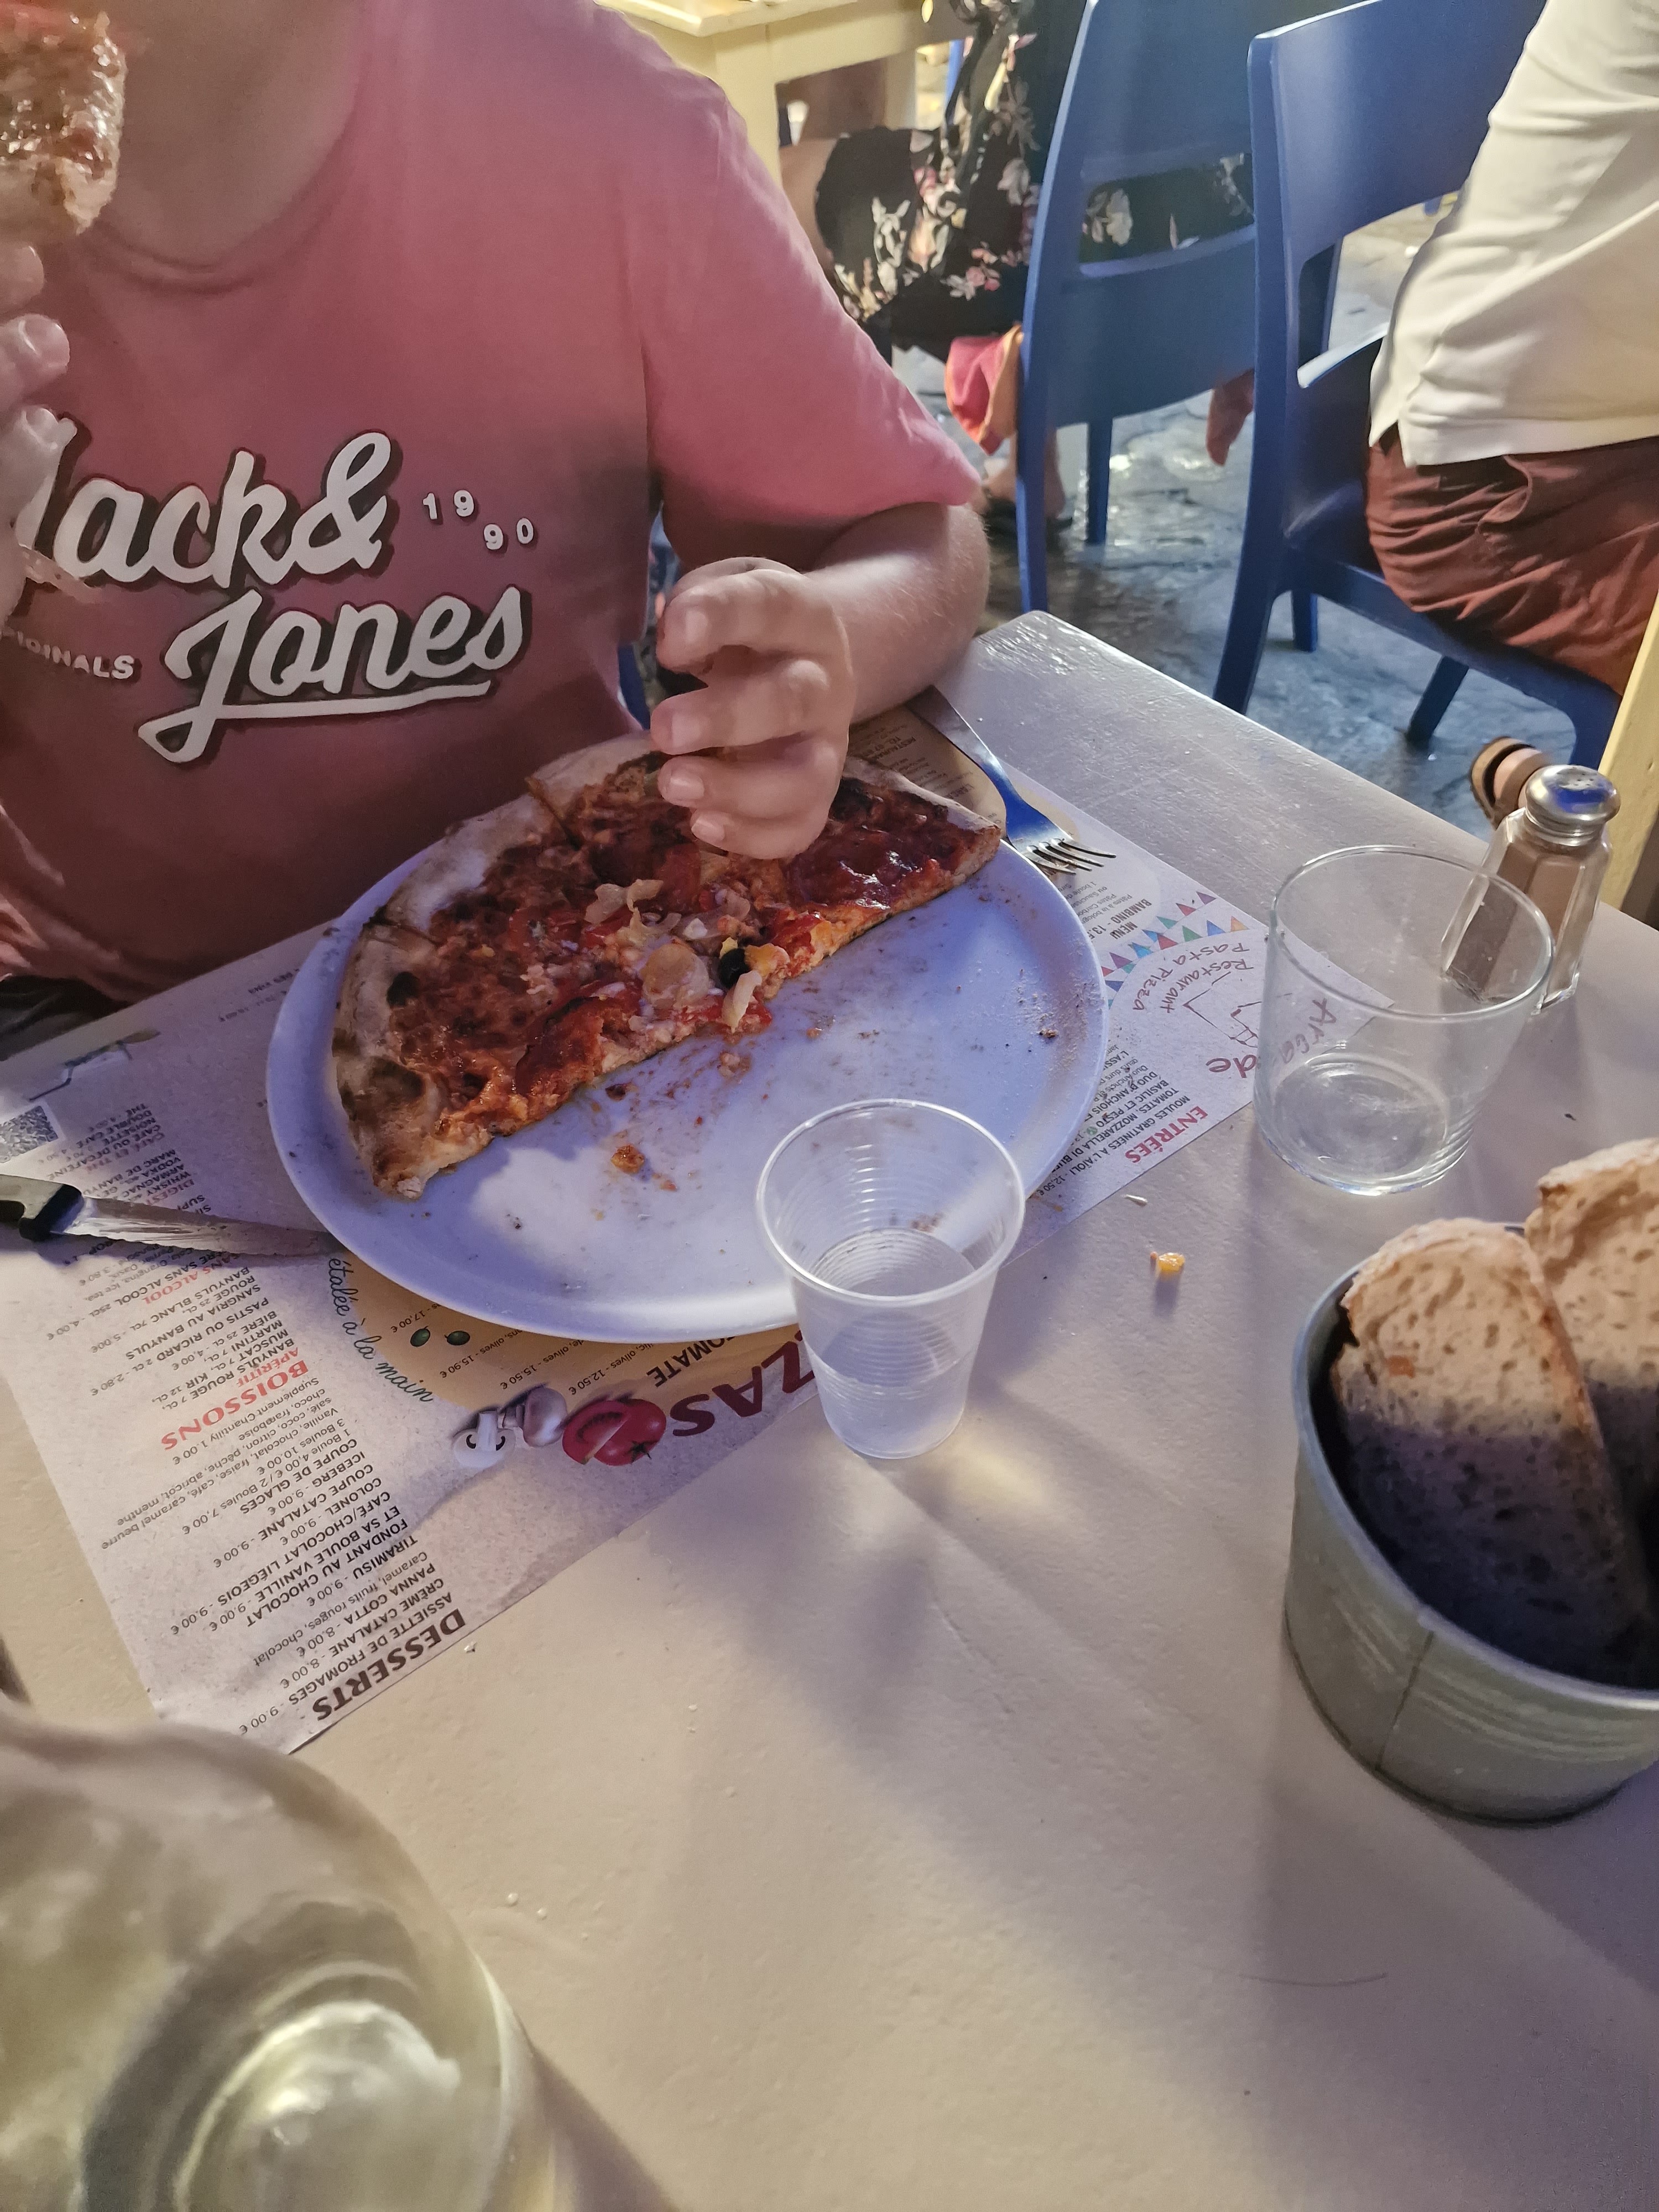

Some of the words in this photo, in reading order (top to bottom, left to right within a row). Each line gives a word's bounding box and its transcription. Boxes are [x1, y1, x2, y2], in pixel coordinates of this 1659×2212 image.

[2, 630, 135, 680] IGINALS
[138, 586, 523, 763] Jones
[1110, 899, 1152, 924] BAMBINO
[1172, 942, 1250, 965] Pasta
[1133, 967, 1173, 1011] Pizza
[1160, 958, 1254, 1014] Restaurant
[1131, 1064, 1149, 1077] Duo
[1135, 1070, 1158, 1087] DUO
[1123, 1099, 1136, 1110] ET
[1134, 1079, 1169, 1103] BASILIC
[1153, 1094, 1191, 1120] MOULES
[1081, 1112, 1138, 1152] MOZZARELLA
[1094, 1107, 1124, 1129] PESTO
[1107, 1117, 1156, 1151] GRATINÉES
[1125, 1104, 1208, 1165] ENTRÉES
[164, 1261, 197, 1281] SANS
[194, 1266, 249, 1299] BANYULS
[113, 1278, 161, 1305] ALCOOL
[141, 1271, 197, 1304] ALCOOL
[207, 1284, 260, 1316] SANGRIA
[213, 1275, 255, 1301] ROUGE
[150, 1297, 192, 1322] BLANC
[187, 1313, 204, 1327] AU
[225, 1297, 269, 1324] PASTIS
[239, 1311, 277, 1334] BIÈRE
[125, 1324, 184, 1359] BANYULS
[205, 1321, 224, 1335] OU
[231, 1319, 283, 1352] MARTINI
[328, 1258, 359, 1317] étalée
[354, 1335, 382, 1360] la
[375, 1362, 433, 1402] main
[156, 1332, 203, 1361] RICARD
[236, 1338, 294, 1373] BANYULS
[238, 1328, 289, 1361] MUSCAT
[479, 1337, 505, 1354] olives
[542, 1347, 569, 1363] olives
[611, 1350, 636, 1369] olives
[236, 1347, 298, 1387] APÉRITIF
[646, 1336, 735, 1387] OMATE
[185, 1372, 208, 1389] KIR
[189, 1370, 234, 1400] ROUGE
[256, 1378, 319, 1415] Supplément
[670, 1330, 816, 1437] ZAS
[161, 1359, 309, 1451] BOISSONS
[210, 1413, 256, 1442] Chantilly
[238, 1408, 290, 1440] framboise
[299, 1423, 336, 1448] Boules
[336, 1418, 345, 1427] 3
[311, 1433, 341, 1454] Boule
[312, 1438, 357, 1469] COUPE
[292, 1465, 312, 1482] DE
[311, 1451, 365, 1487] ICEBERG
[328, 1464, 373, 1496] COUPE
[117, 1497, 159, 1525] menthe
[140, 1496, 185, 1527] caramel
[220, 1484, 258, 1509] Boules
[239, 1479, 290, 1514] GLACES
[324, 1477, 382, 1515] COLONEL
[257, 1493, 326, 1541] CATALANE
[284, 1491, 390, 1564] CAFÉ/CHOCOLAT
[361, 1518, 380, 1533] SA
[384, 1505, 401, 1522] ET
[101, 1524, 139, 1549] beurre
[313, 1530, 361, 1565] BOULE
[346, 1518, 408, 1564] FONDANT
[321, 1557, 341, 1577] AU
[352, 1534, 418, 1579] TIRAMISU
[217, 1559, 280, 1606] LIÉGEOIS
[254, 1561, 313, 1603] VANILLE
[347, 1579, 378, 1604] fruits
[389, 1562, 435, 1596] PANNA
[399, 1578, 444, 1612] CRÈME
[246, 1574, 319, 1627] CHOCOLAT
[343, 1594, 388, 1625] COTTA
[389, 1591, 452, 1639] ASSIETTE
[252, 1629, 303, 1667] chocolat
[328, 1608, 398, 1657] CATALANE
[367, 1634, 388, 1653] DE
[288, 1649, 366, 1705] FROMAGES
[312, 1608, 466, 1721] DESSERTS
